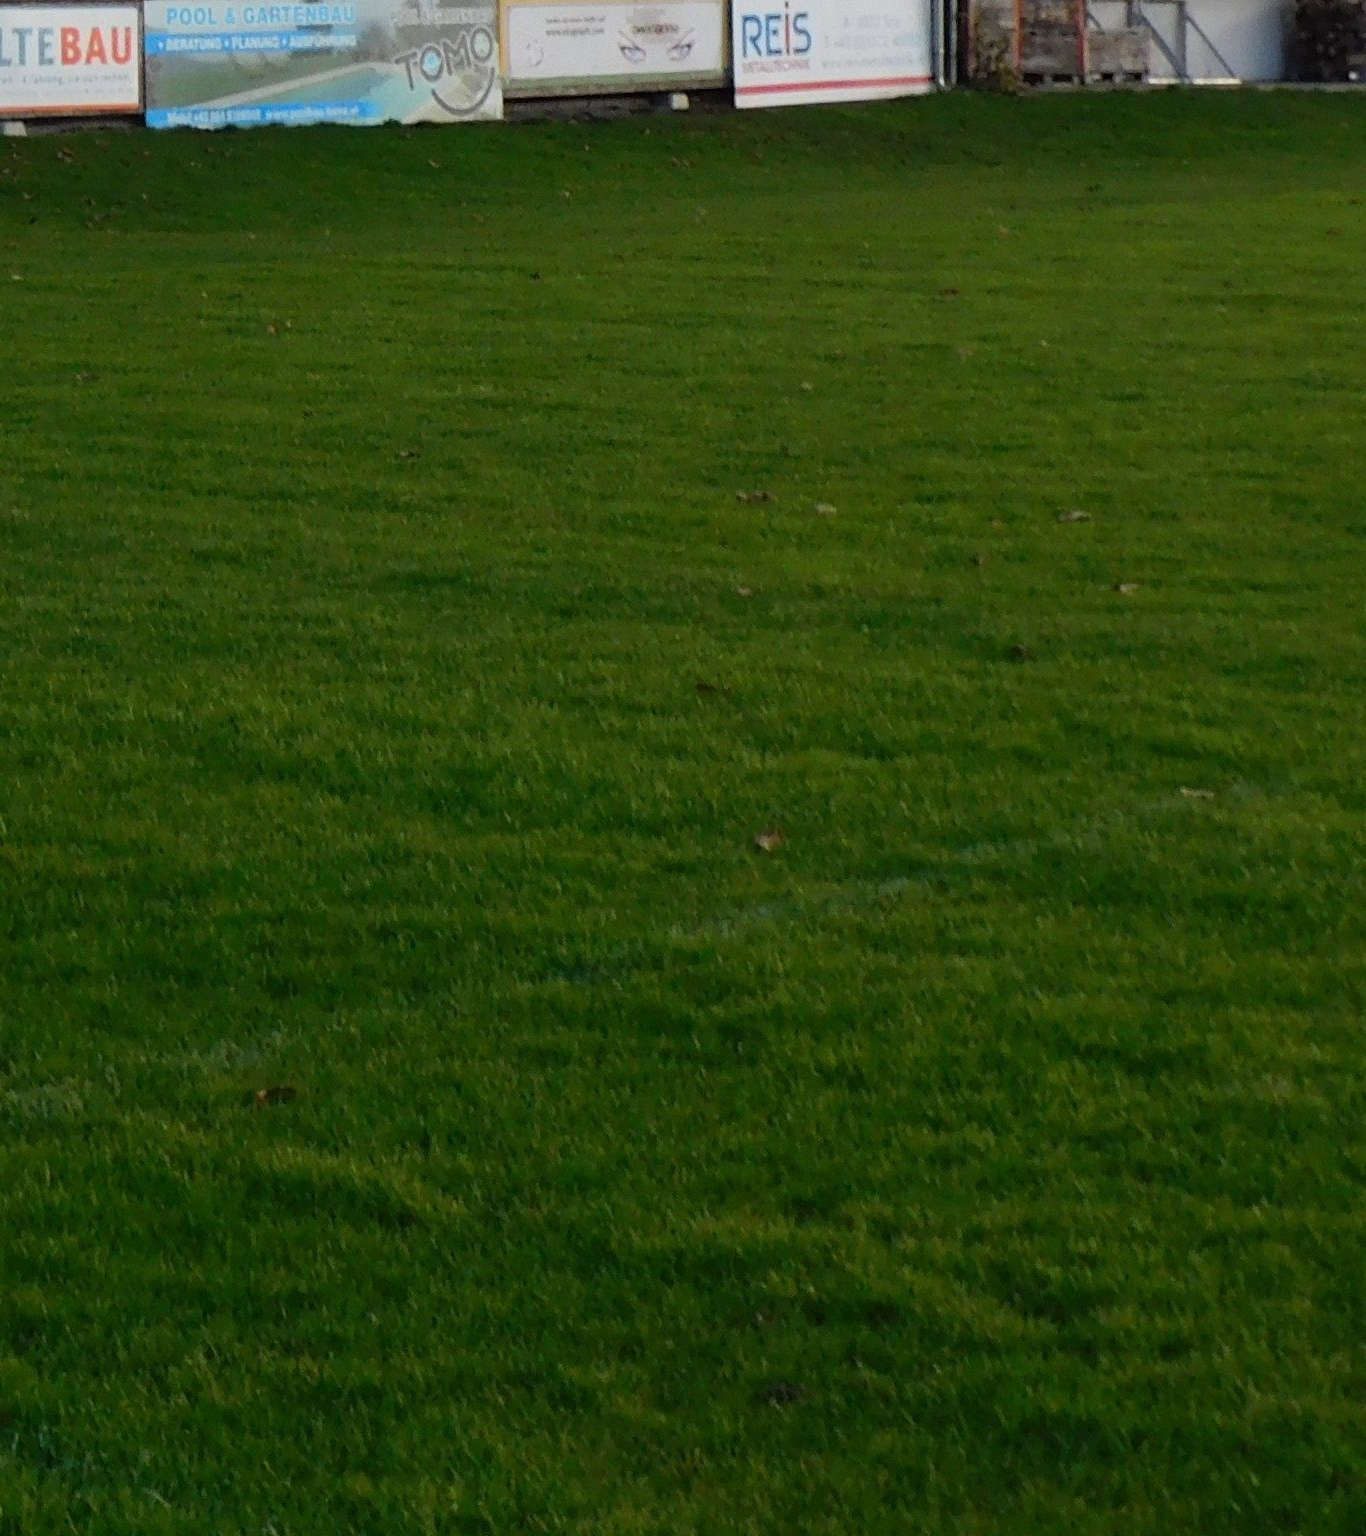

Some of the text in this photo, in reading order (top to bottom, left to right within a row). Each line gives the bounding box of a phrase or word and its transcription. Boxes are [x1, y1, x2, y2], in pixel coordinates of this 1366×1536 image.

[166, 7, 217, 25] POOL
[243, 5, 355, 24] GARTENBAU
[394, 27, 494, 91] TOMO
